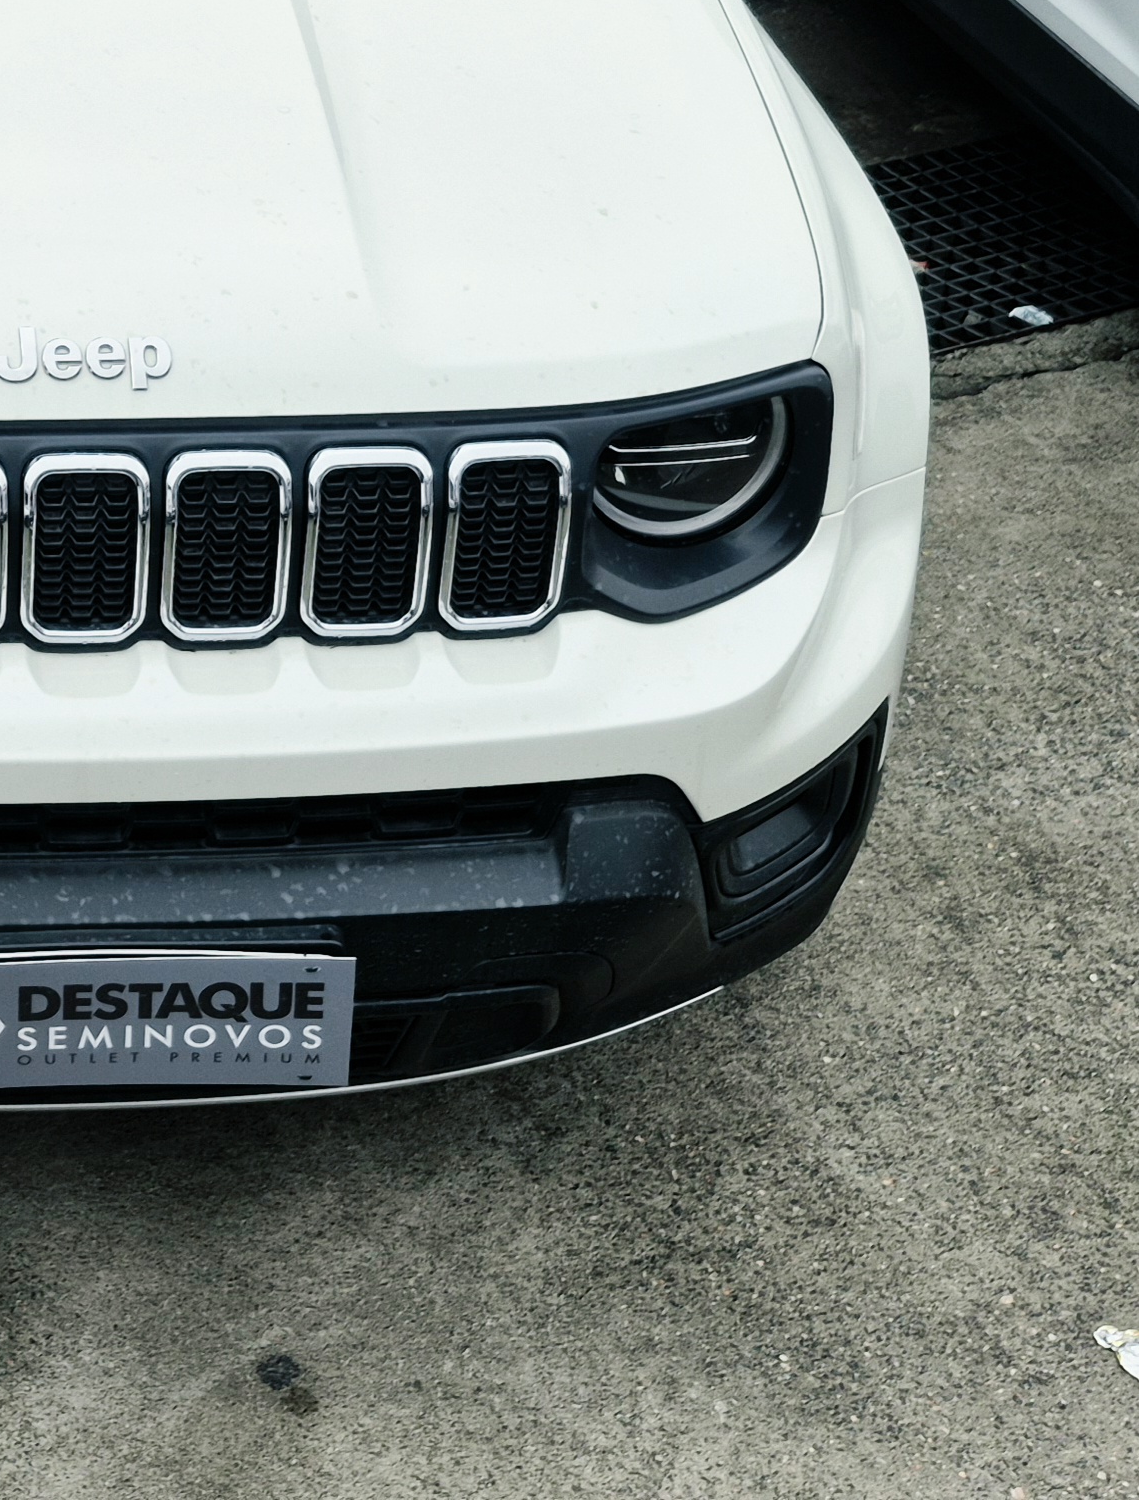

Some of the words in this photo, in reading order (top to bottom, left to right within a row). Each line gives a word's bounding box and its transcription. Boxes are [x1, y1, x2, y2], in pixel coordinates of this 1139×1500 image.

[17, 981, 326, 1023] DESTAQUE
[17, 1024, 324, 1052] SEMINOVOS
[17, 1051, 140, 1066] OUTLET
[169, 1051, 322, 1065] PREMIUM
